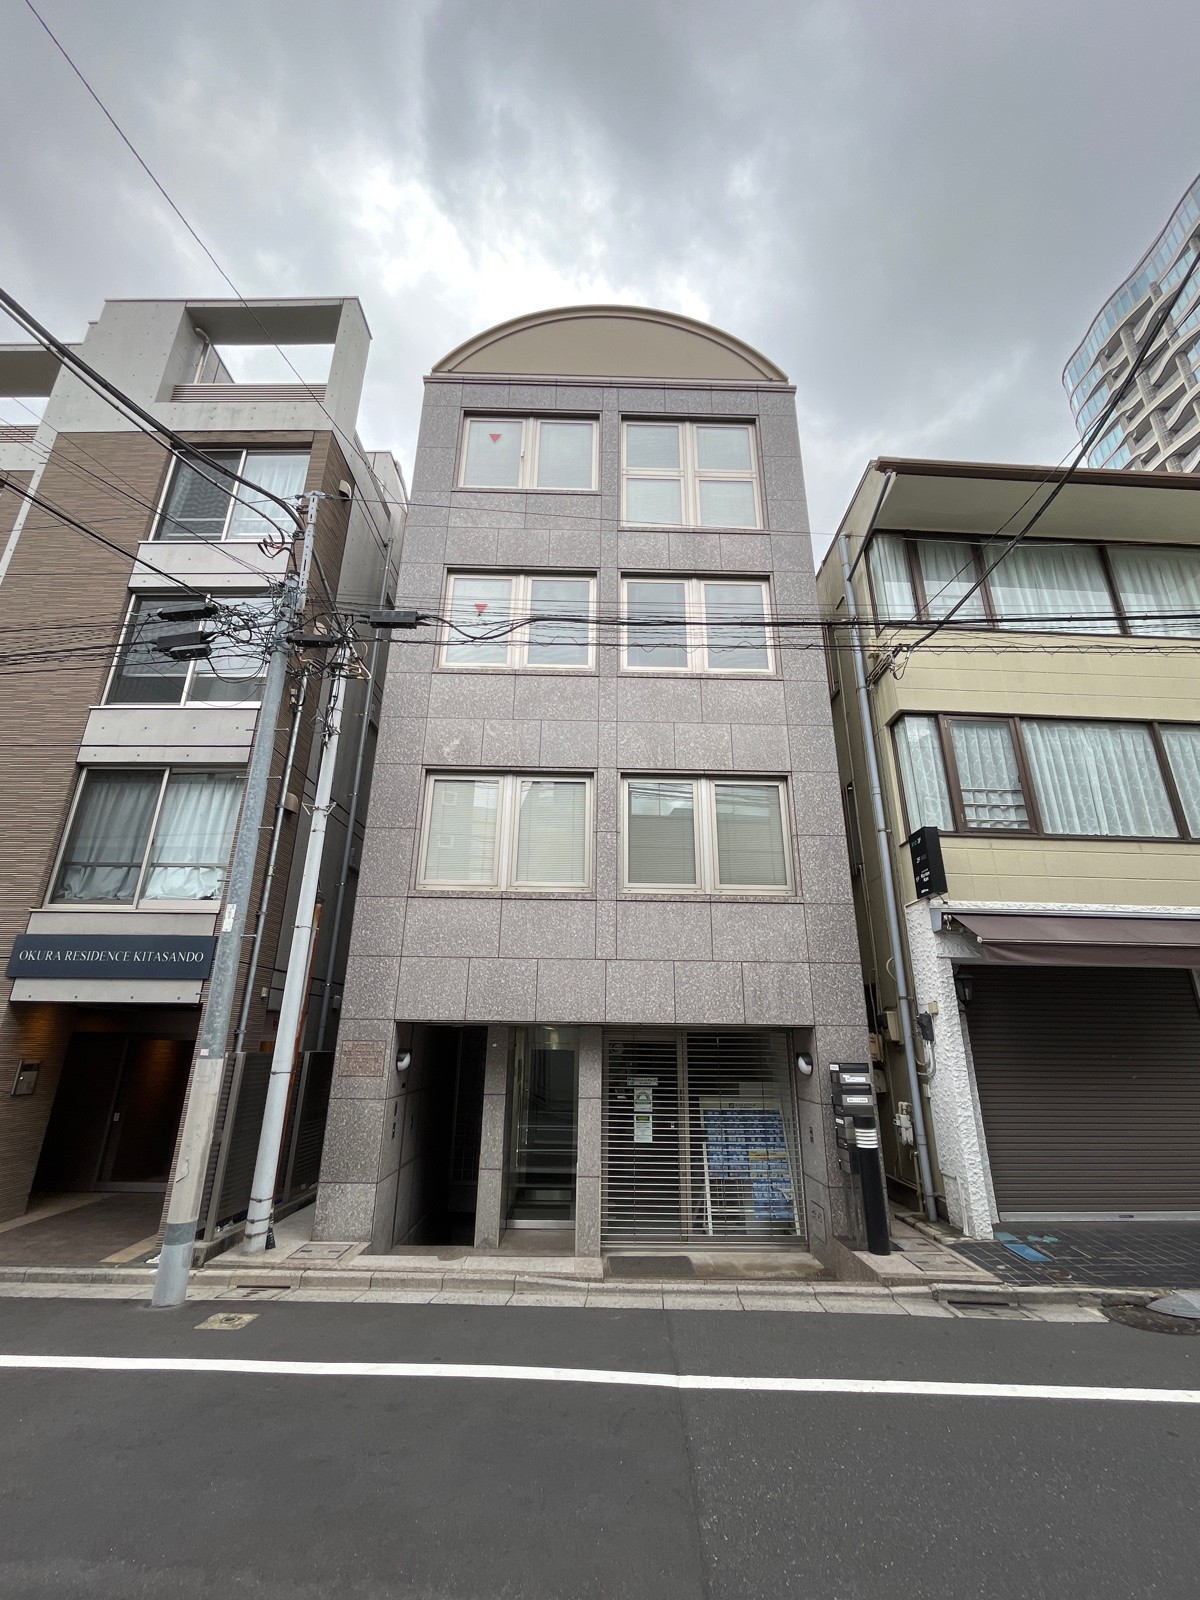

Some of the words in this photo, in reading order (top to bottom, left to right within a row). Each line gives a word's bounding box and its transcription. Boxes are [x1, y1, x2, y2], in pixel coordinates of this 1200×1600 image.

[18, 949, 62, 962] OKURA
[64, 949, 130, 963] RESIDENCE
[133, 950, 205, 963] KITASANDO
